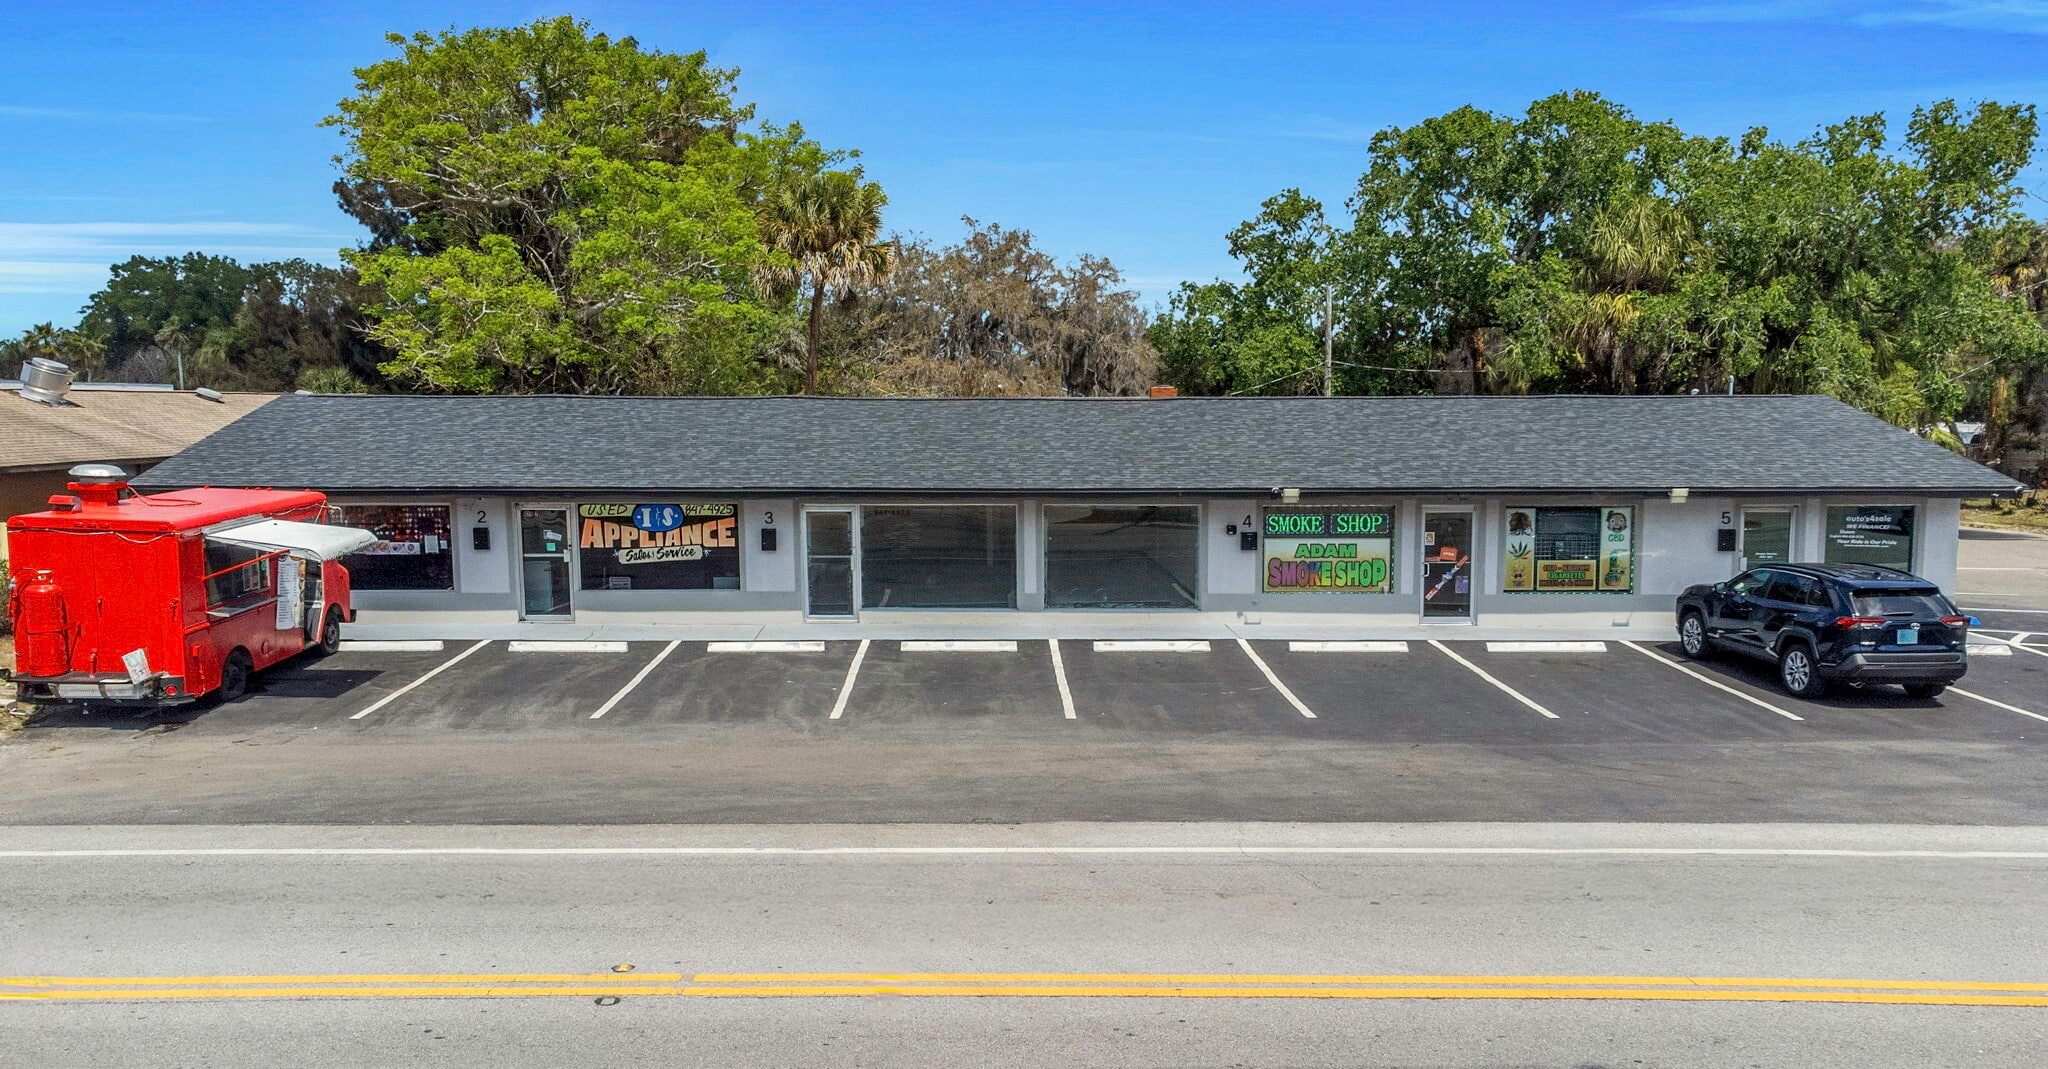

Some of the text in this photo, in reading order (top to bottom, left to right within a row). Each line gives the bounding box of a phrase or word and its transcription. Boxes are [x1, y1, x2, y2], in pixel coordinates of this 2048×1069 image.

[587, 504, 628, 516] USED
[685, 503, 733, 515] 847-4925
[477, 510, 487, 523] 2
[663, 507, 673, 526] S
[764, 511, 774, 524] 3
[1242, 514, 1252, 527] 4
[1721, 511, 1731, 524] 5
[1268, 514, 1382, 533] SMOKE SHOP
[580, 518, 736, 548] APPLIANCE
[656, 547, 696, 560] Service
[1294, 543, 1358, 558] ADAM
[1267, 557, 1387, 588] SMOKE SHOP
